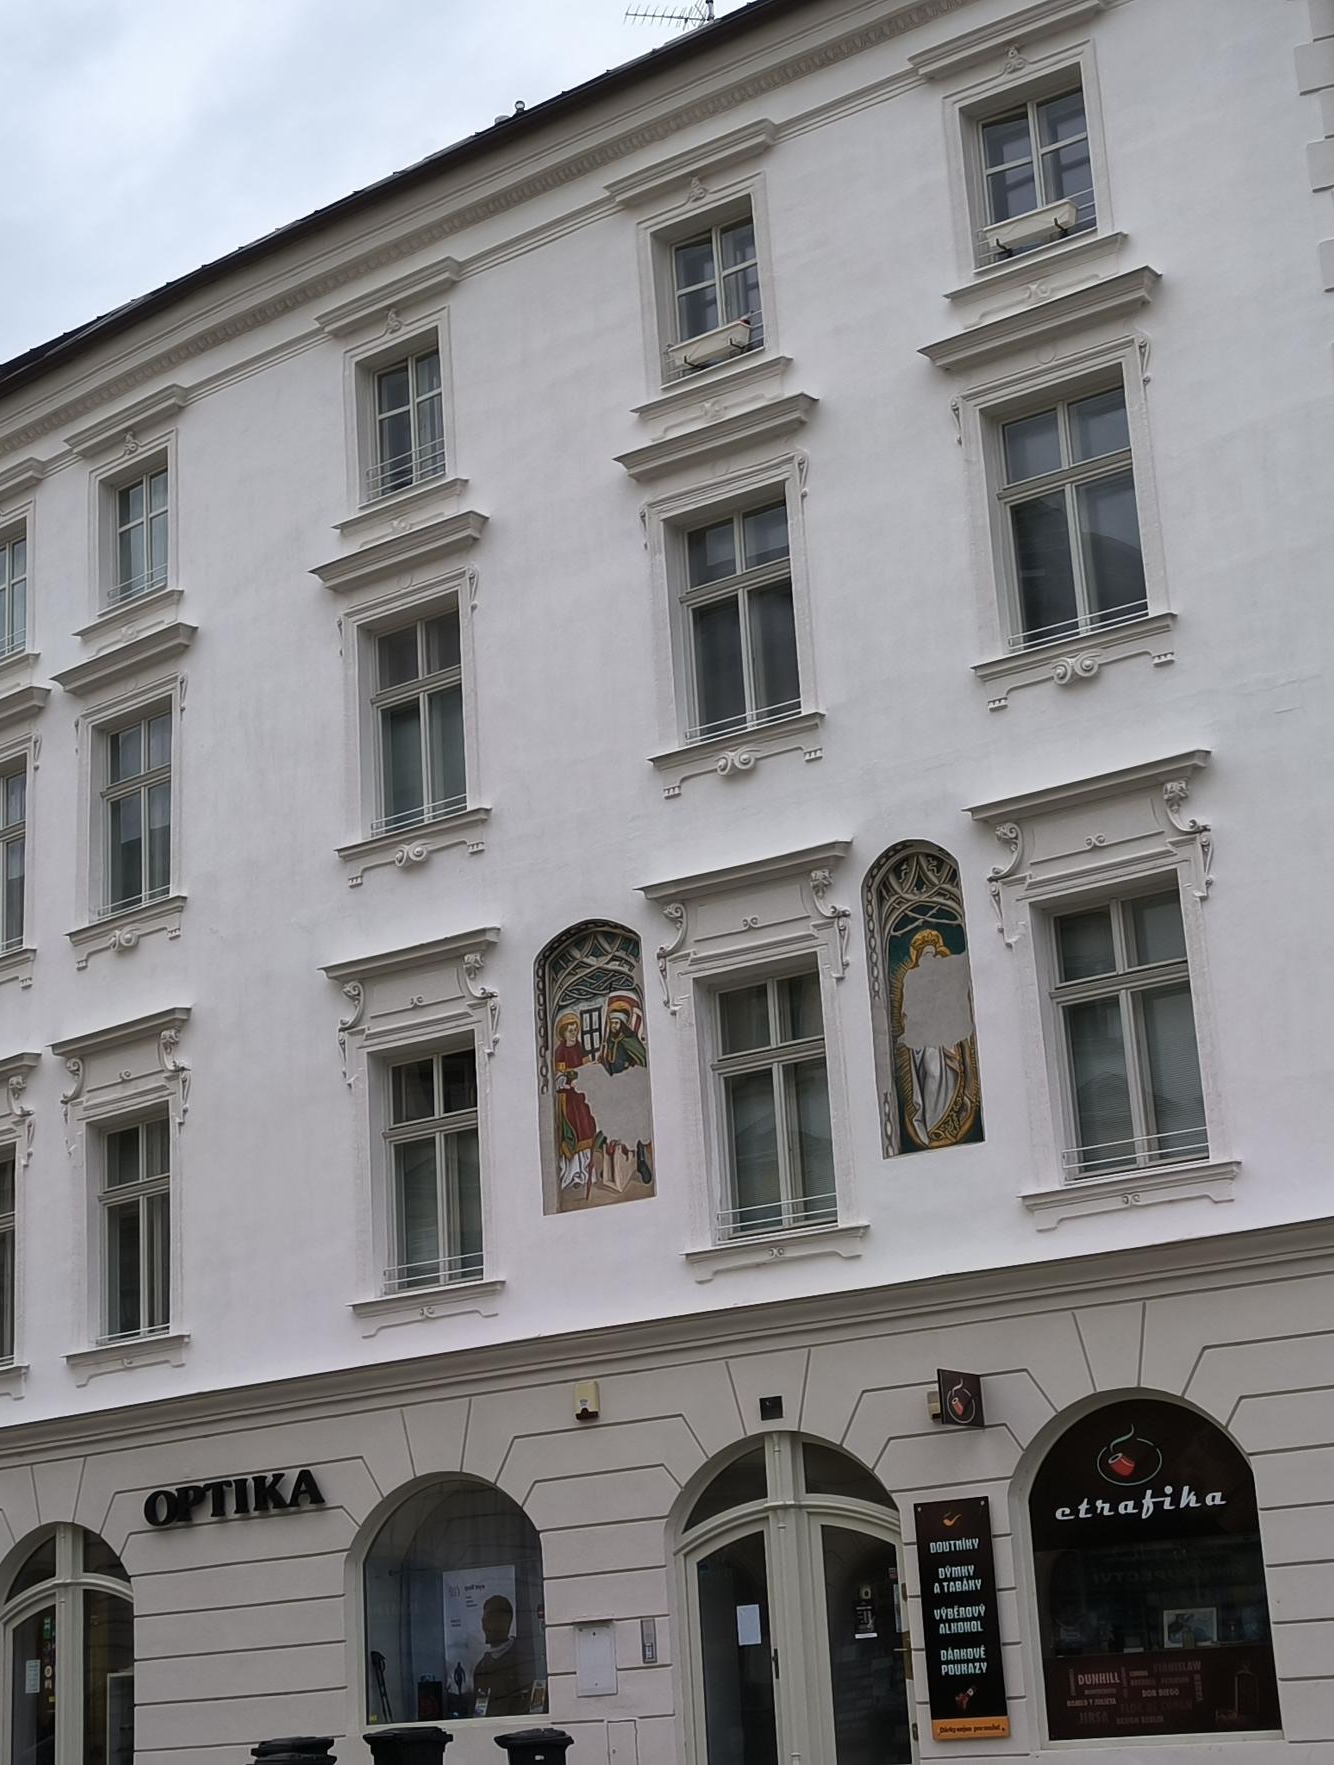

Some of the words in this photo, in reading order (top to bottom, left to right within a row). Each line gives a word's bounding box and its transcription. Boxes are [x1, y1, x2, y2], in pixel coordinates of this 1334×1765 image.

[143, 1468, 326, 1527] OPTIKA
[1054, 1485, 1228, 1521] etrafika
[929, 1537, 980, 1554] DOUTNÍKY
[938, 1564, 975, 1580] DÝMKY
[933, 1582, 941, 1594] A
[942, 1578, 982, 1593] TABÁKY
[933, 1603, 986, 1620] VÝBĚROVÝ
[939, 1620, 984, 1635] ALKOHOL
[940, 1644, 987, 1662] DÁRKOVÉ
[941, 1661, 988, 1677] POUKAZY
[1077, 1671, 1121, 1686] DUNHILL
[1142, 1688, 1157, 1698] DON
[1158, 1687, 1180, 1697] DIEGO
